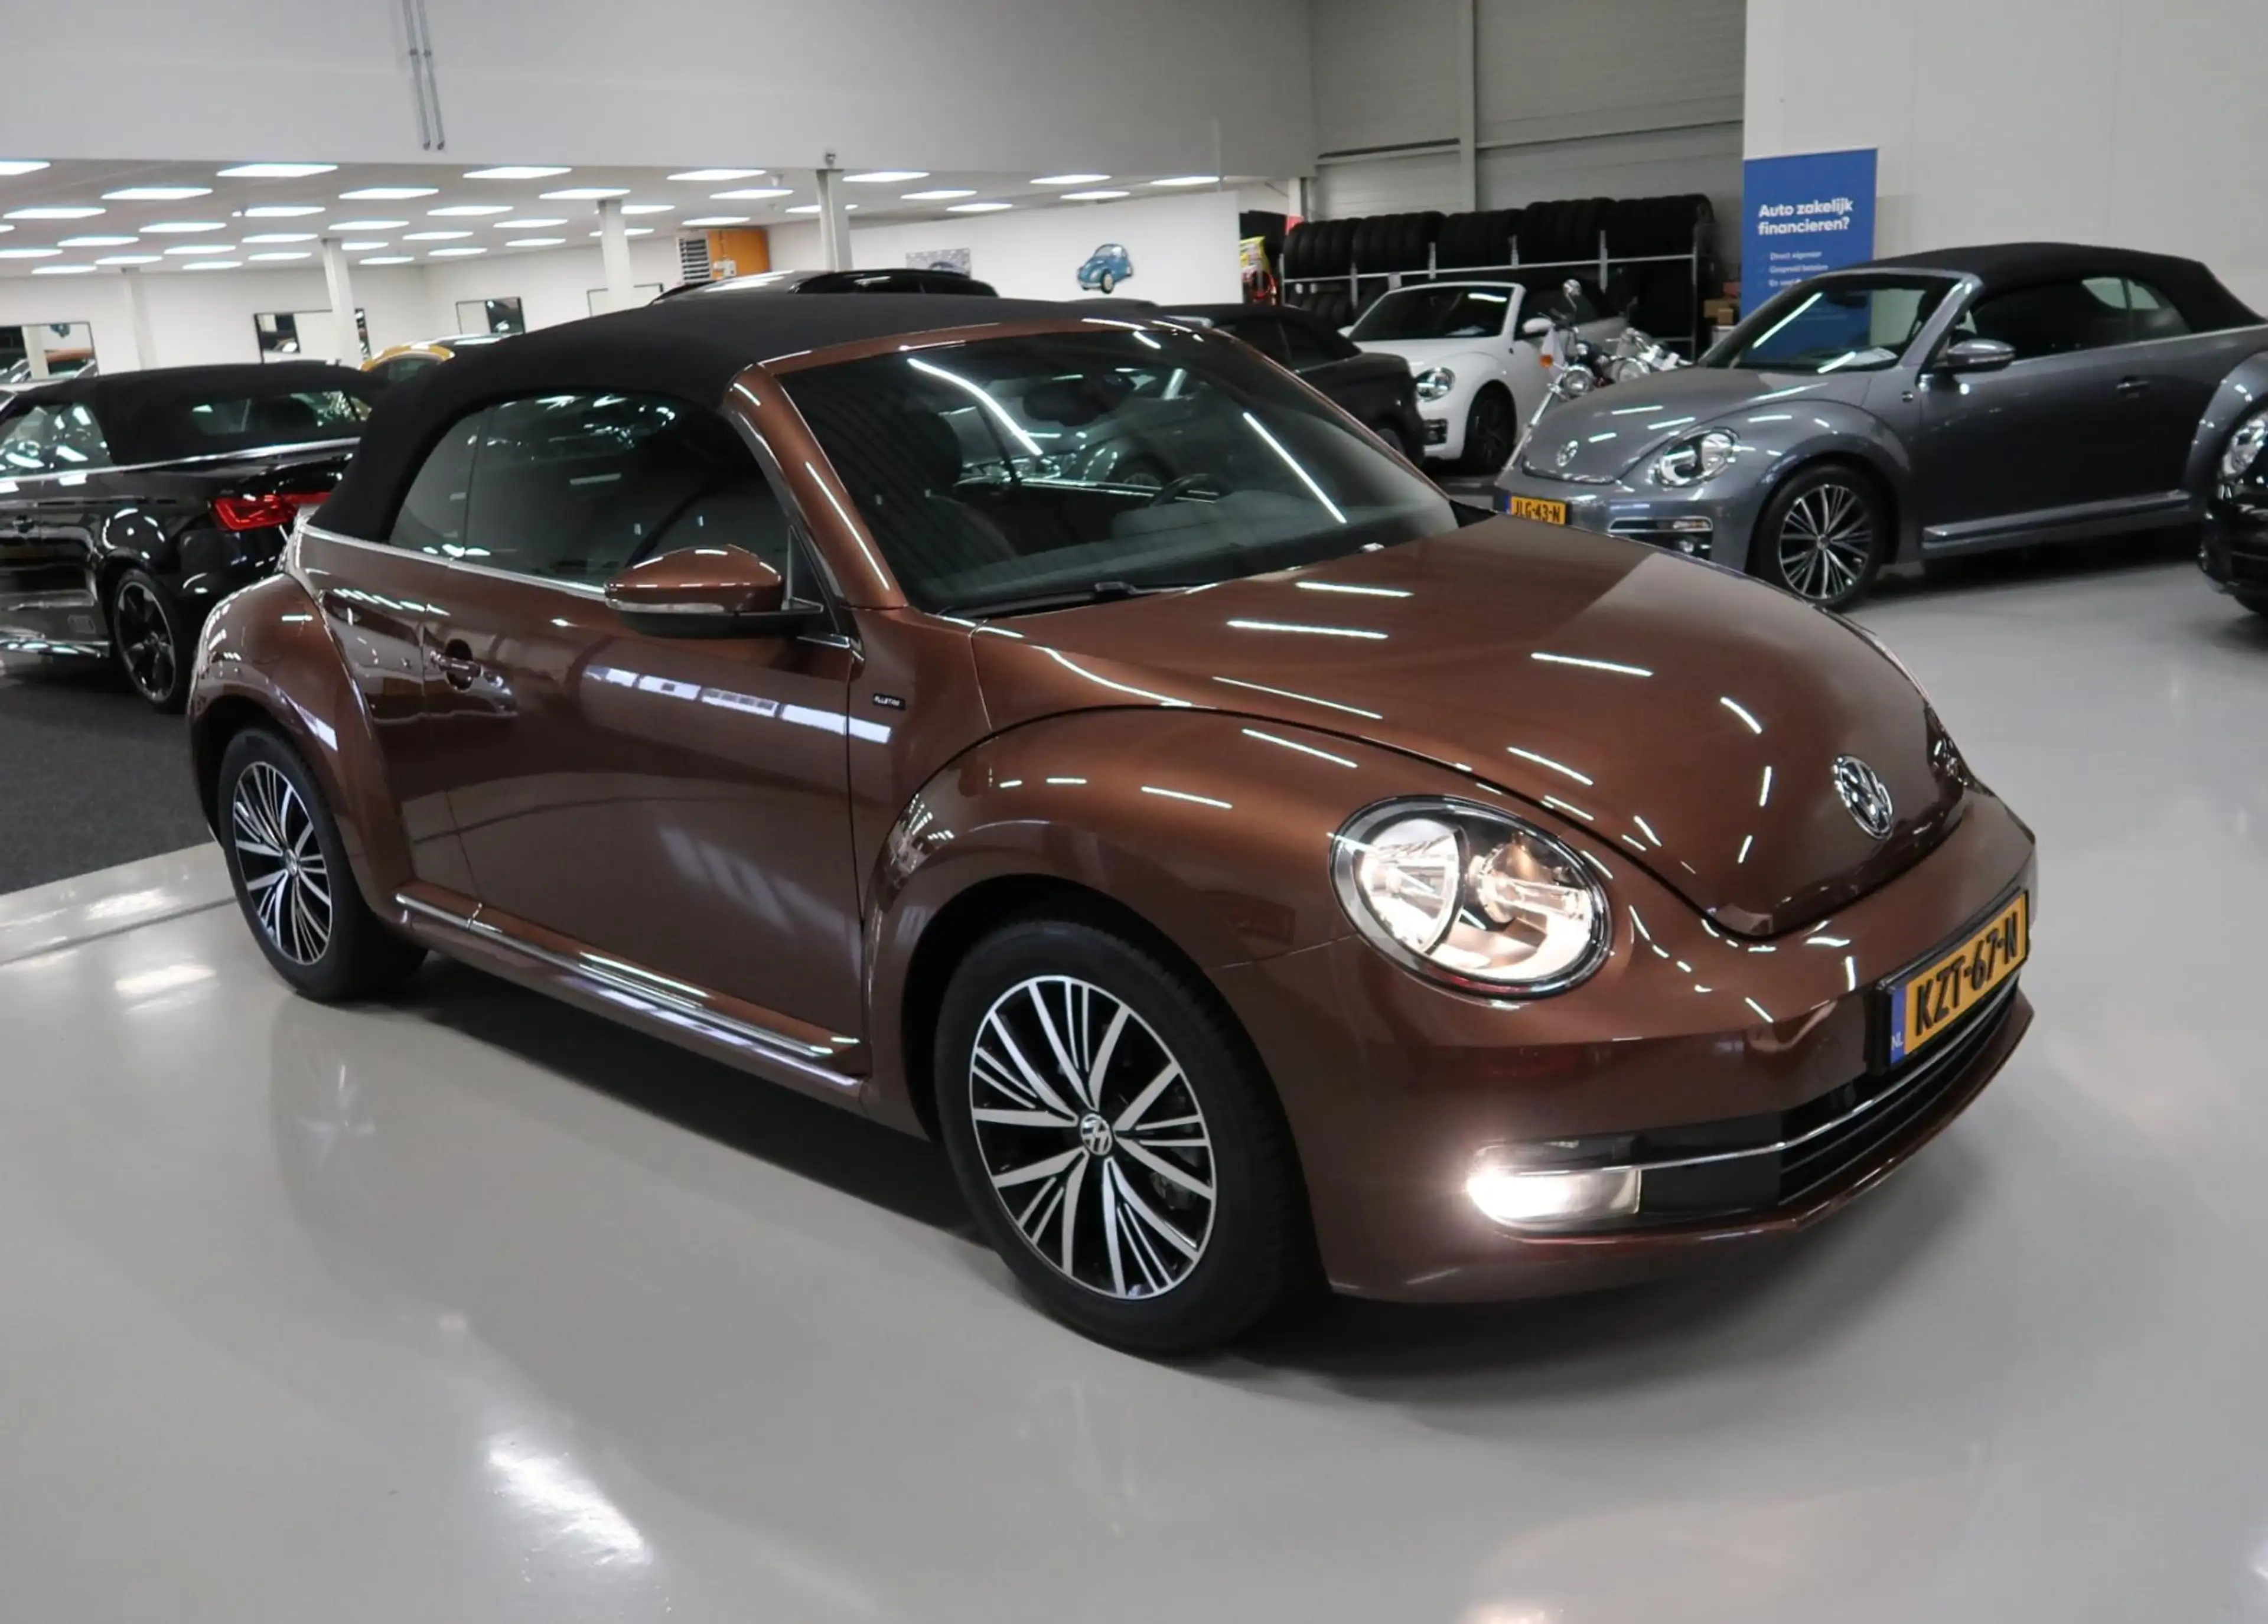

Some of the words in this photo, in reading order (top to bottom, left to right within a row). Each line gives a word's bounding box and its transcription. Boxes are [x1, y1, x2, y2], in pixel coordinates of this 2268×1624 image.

[1759, 204, 1794, 217] Auto
[1796, 198, 1853, 214] zakelijk
[1758, 217, 1850, 235] financieren?
[1916, 911, 2019, 1036] KZT-67-N
